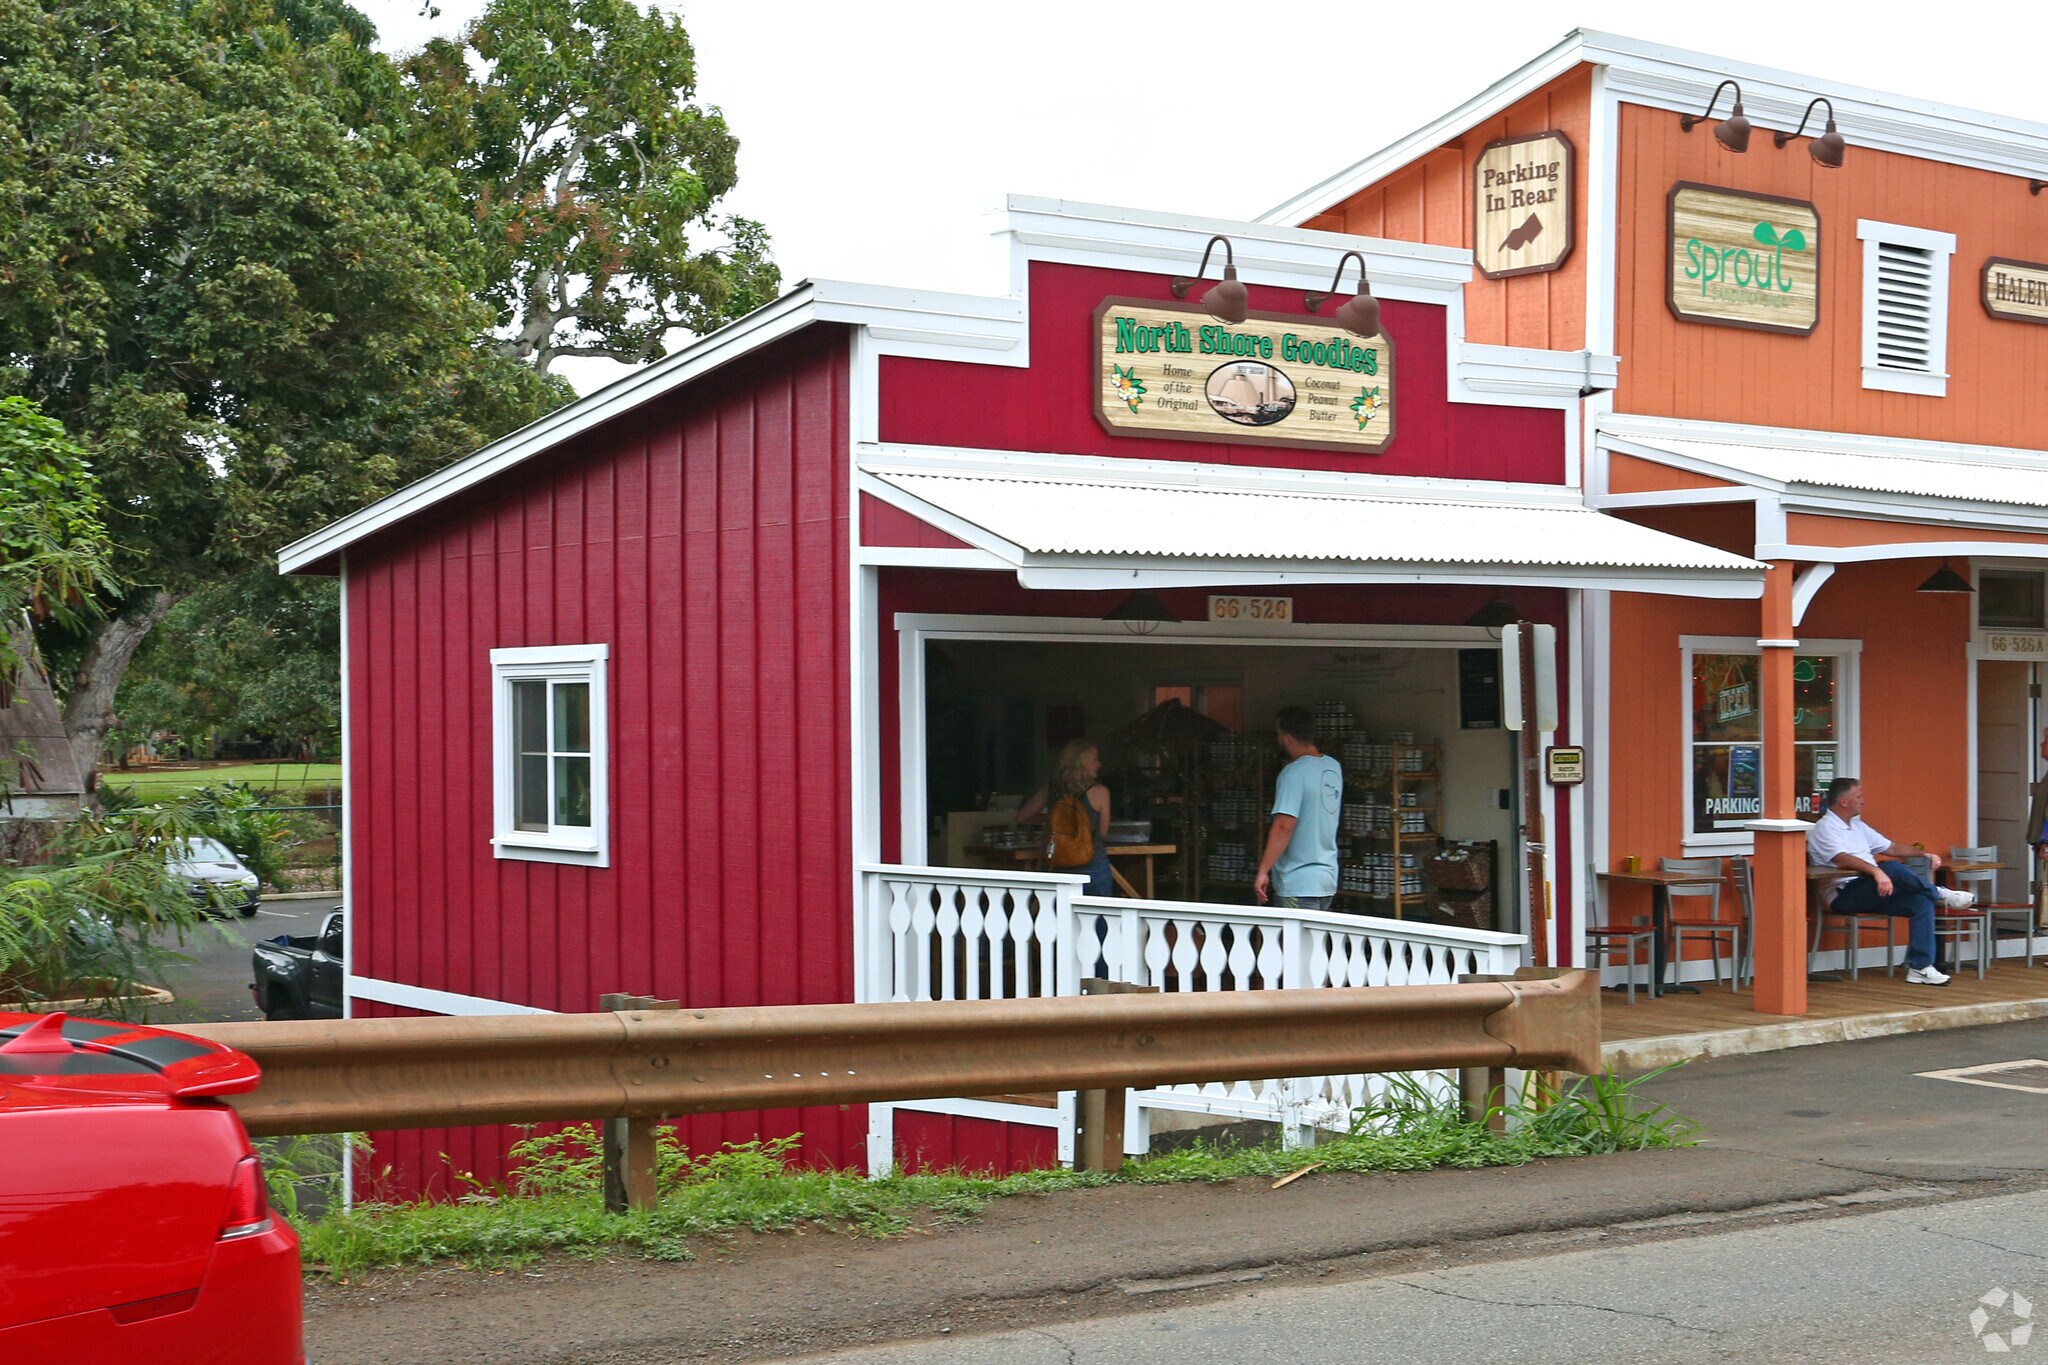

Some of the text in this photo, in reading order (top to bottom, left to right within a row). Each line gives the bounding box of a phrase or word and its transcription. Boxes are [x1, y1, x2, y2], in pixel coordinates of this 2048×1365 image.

[1483, 161, 1560, 188] Parking
[1485, 187, 1557, 213] In Rear
[1115, 317, 1378, 376] North Shore Goodies
[1163, 364, 1192, 377] Home
[1163, 381, 1193, 394] of the
[1304, 376, 1340, 390] Coconut
[1157, 396, 1199, 411] Original
[1308, 393, 1338, 405] Peanut
[1309, 409, 1337, 421] Butter
[1705, 797, 1760, 814] PARKING
